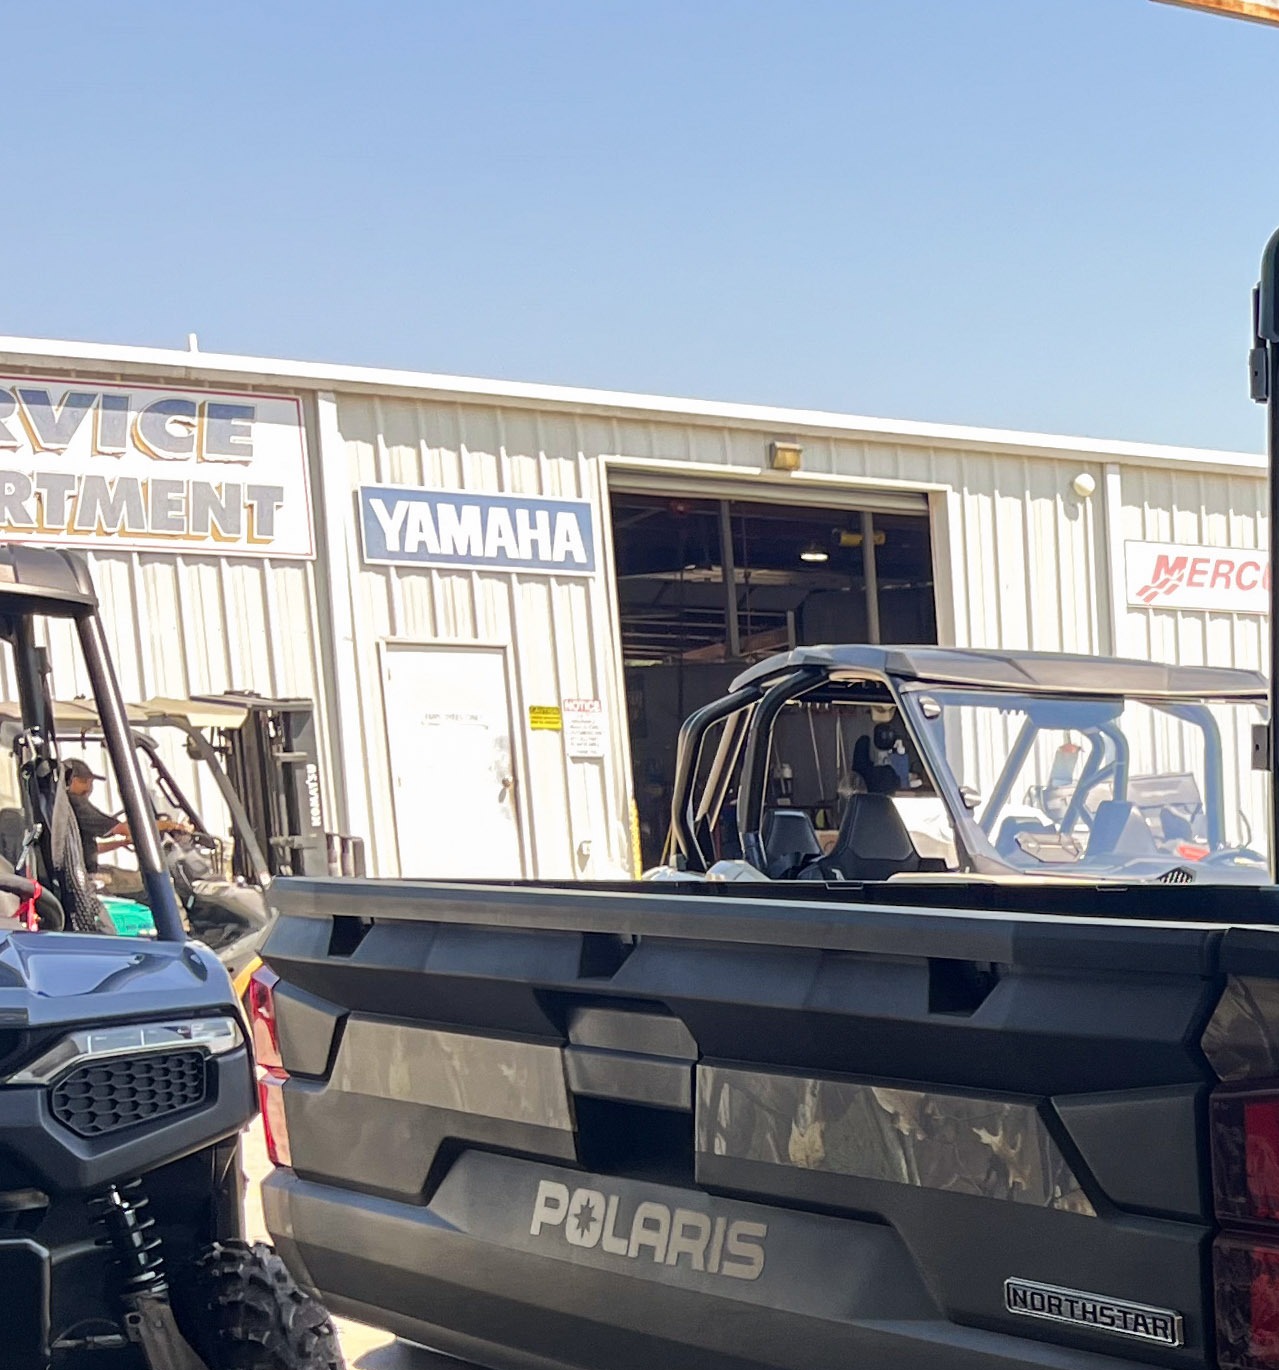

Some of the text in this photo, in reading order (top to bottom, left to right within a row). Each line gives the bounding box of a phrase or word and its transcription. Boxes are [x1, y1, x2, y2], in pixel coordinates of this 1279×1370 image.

[369, 498, 588, 564] YAMAHA
[530, 1180, 767, 1280] POLARIS
[1011, 1286, 1169, 1340] NORTHSTAR
